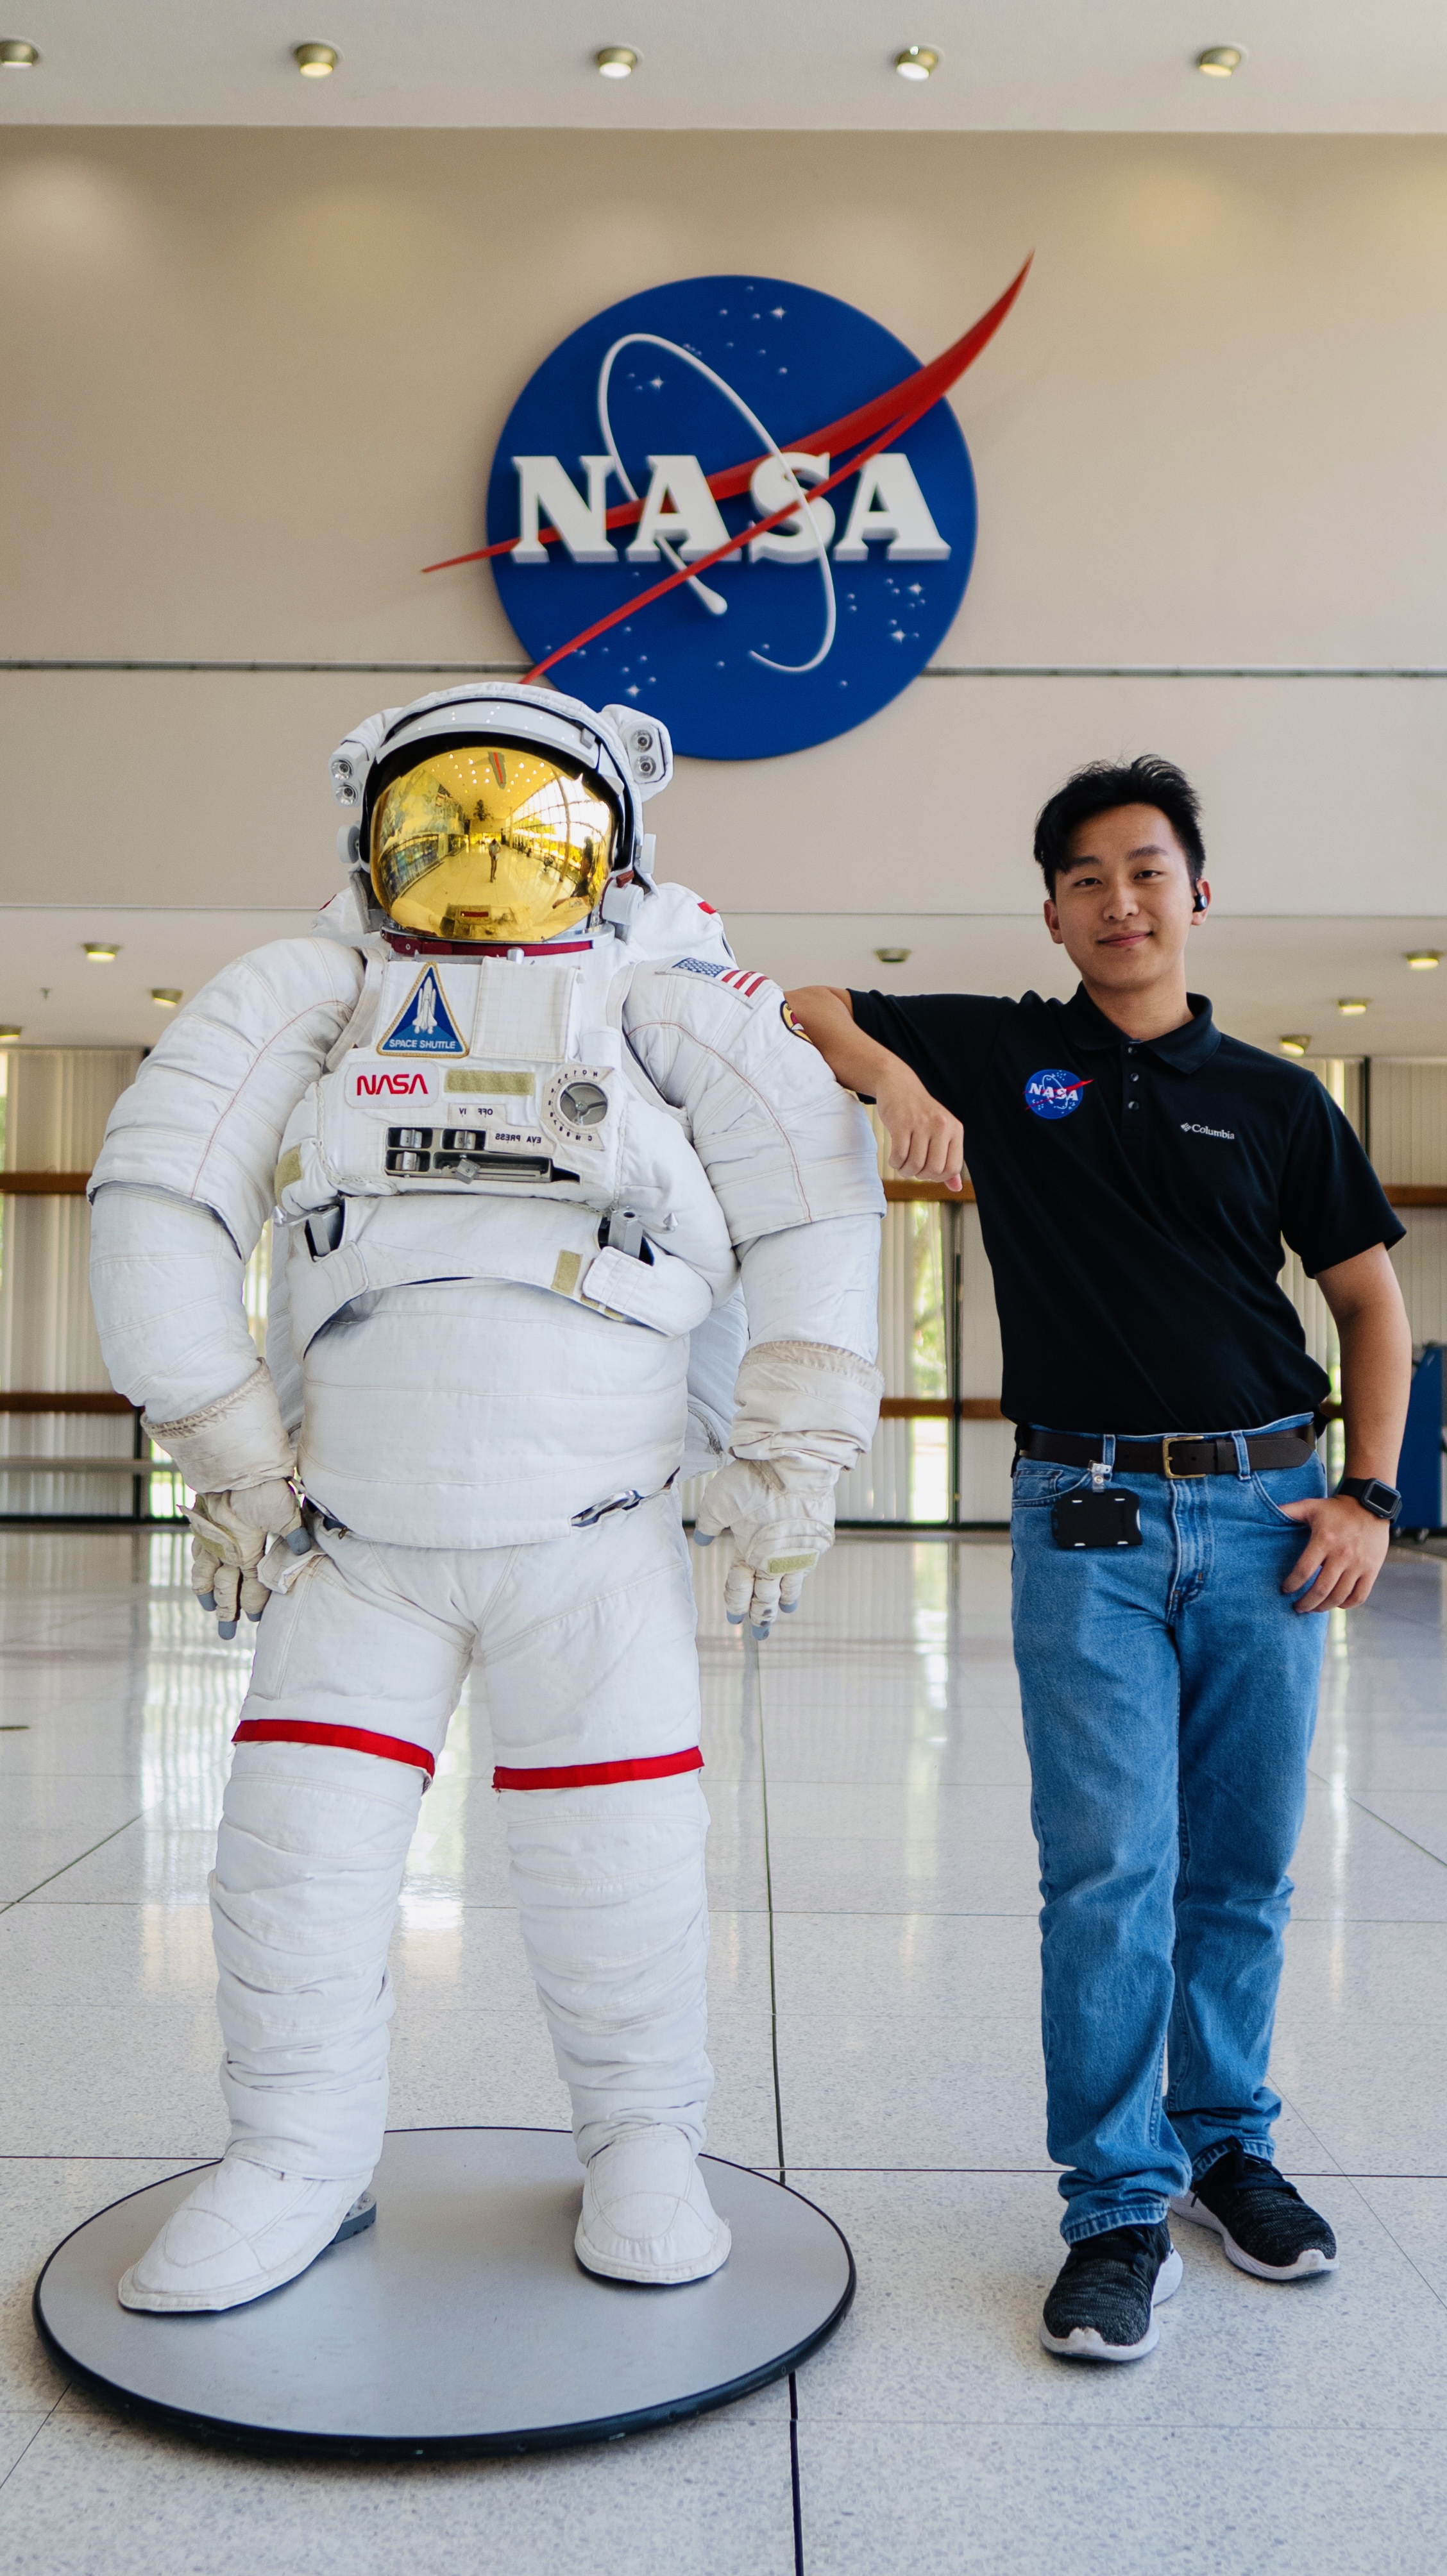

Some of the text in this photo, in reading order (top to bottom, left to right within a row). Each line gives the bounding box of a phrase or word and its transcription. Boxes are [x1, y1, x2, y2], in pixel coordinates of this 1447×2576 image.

[512, 452, 951, 563] NASA
[389, 1039, 455, 1049] SPACE SHUTTLE
[357, 1074, 428, 1096] NASA
[1029, 1083, 1078, 1101] NASA
[1192, 1124, 1235, 1139] Columbia
